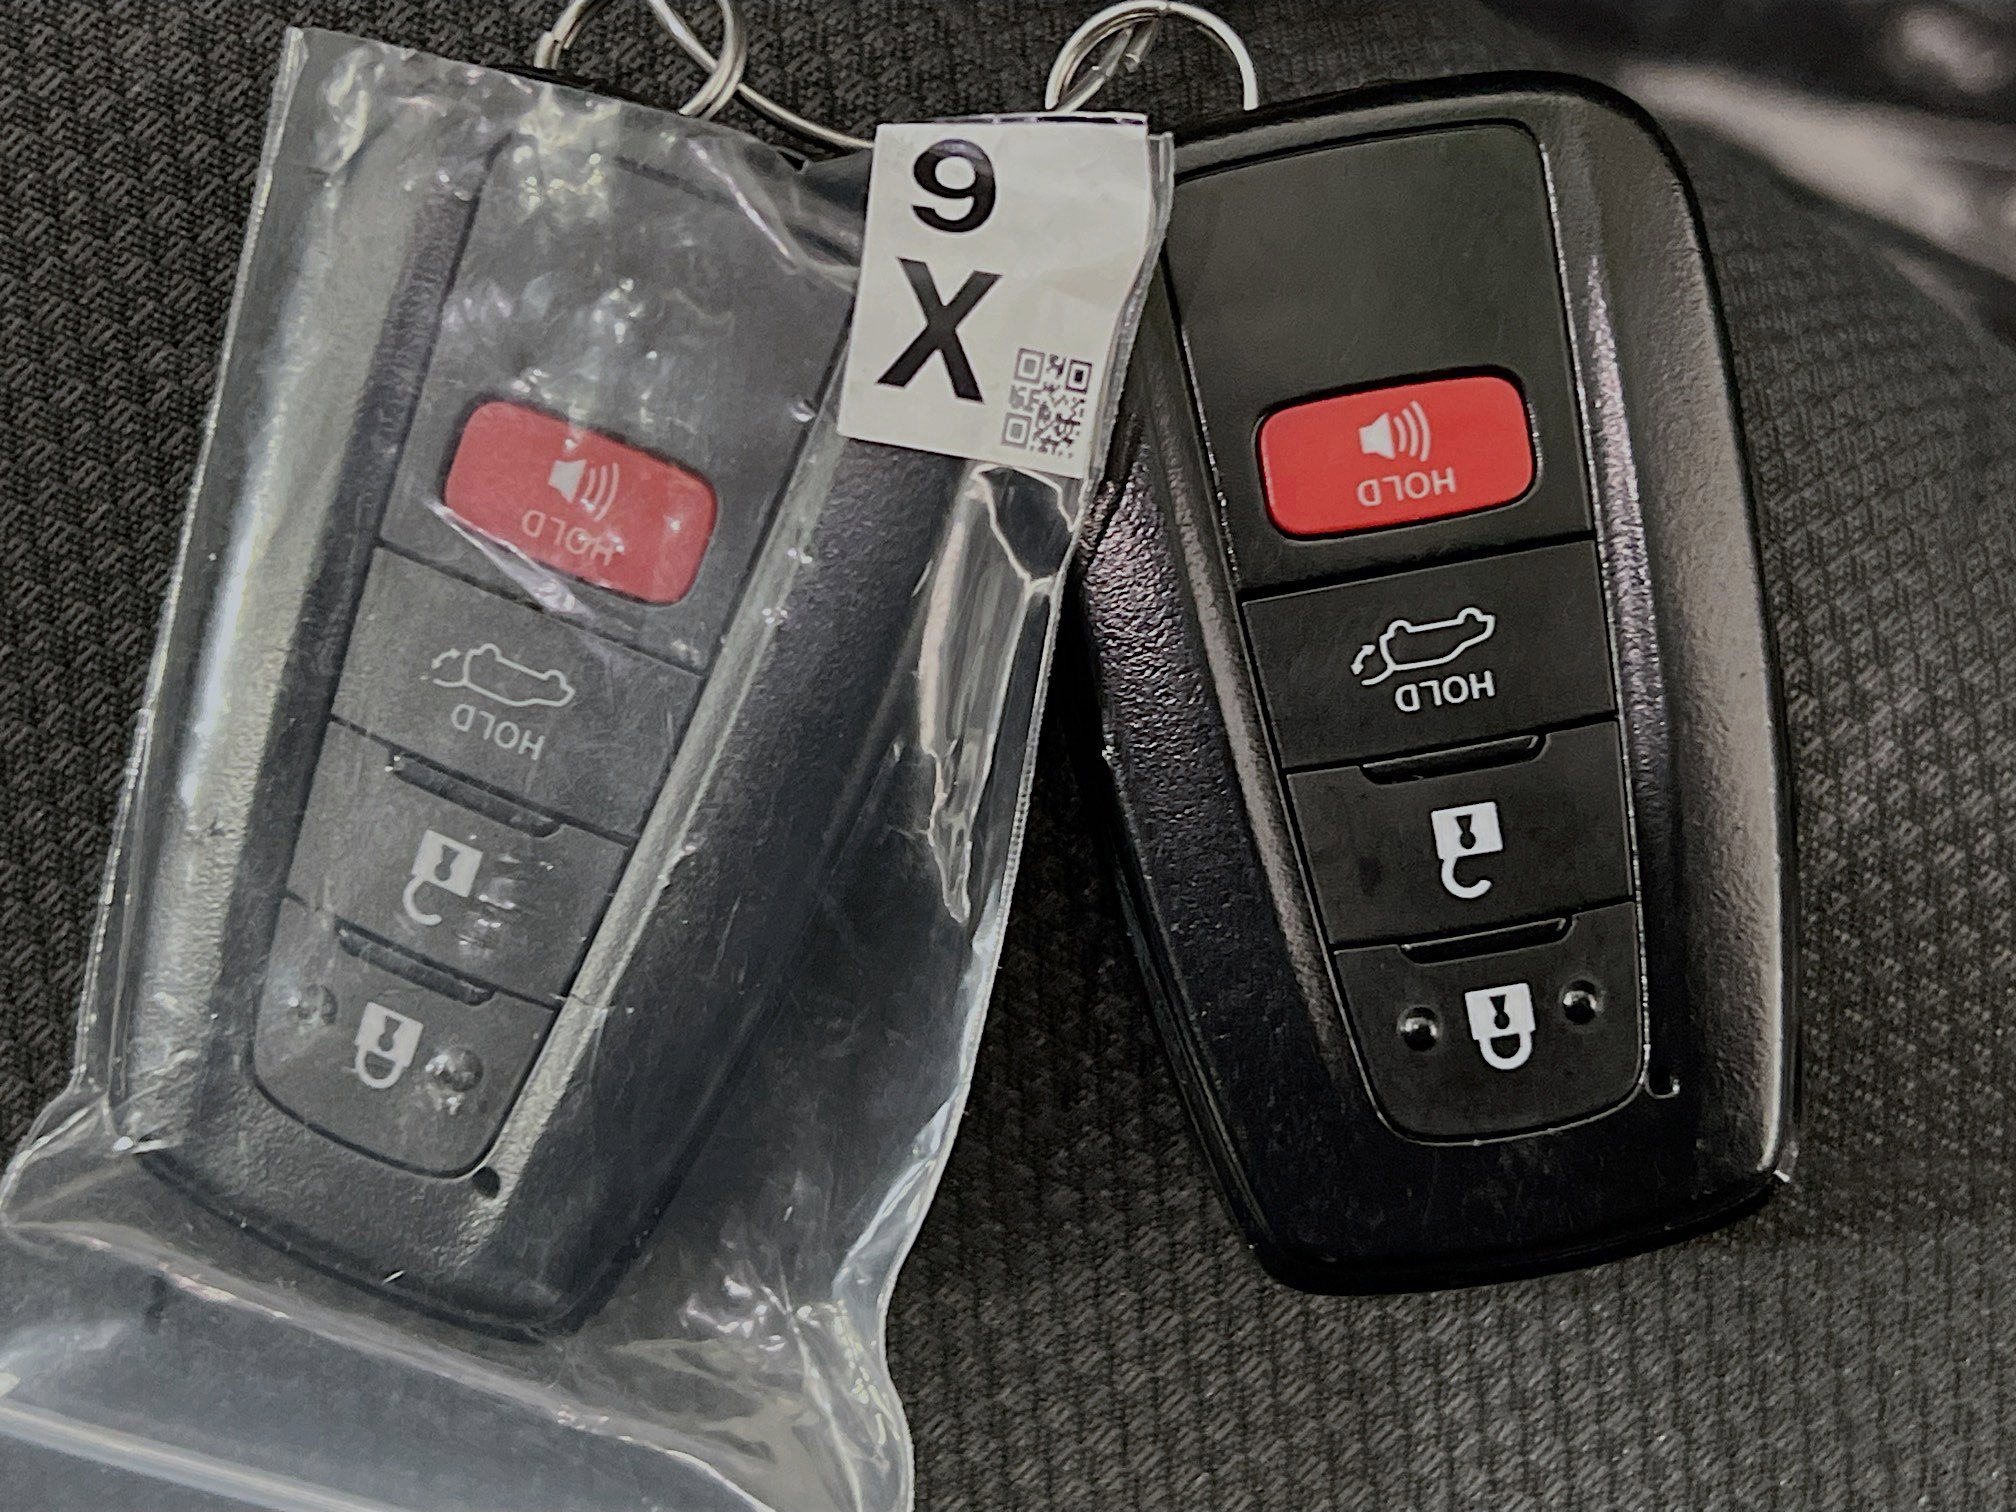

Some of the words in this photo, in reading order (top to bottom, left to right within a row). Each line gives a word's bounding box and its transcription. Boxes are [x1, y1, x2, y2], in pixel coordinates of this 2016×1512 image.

[911, 138, 997, 233] 9
[876, 256, 1003, 405] X
[1356, 466, 1457, 508] HOLD
[520, 509, 623, 566] HOLD
[1394, 670, 1496, 713] HOLD
[451, 703, 547, 760] HOLD
